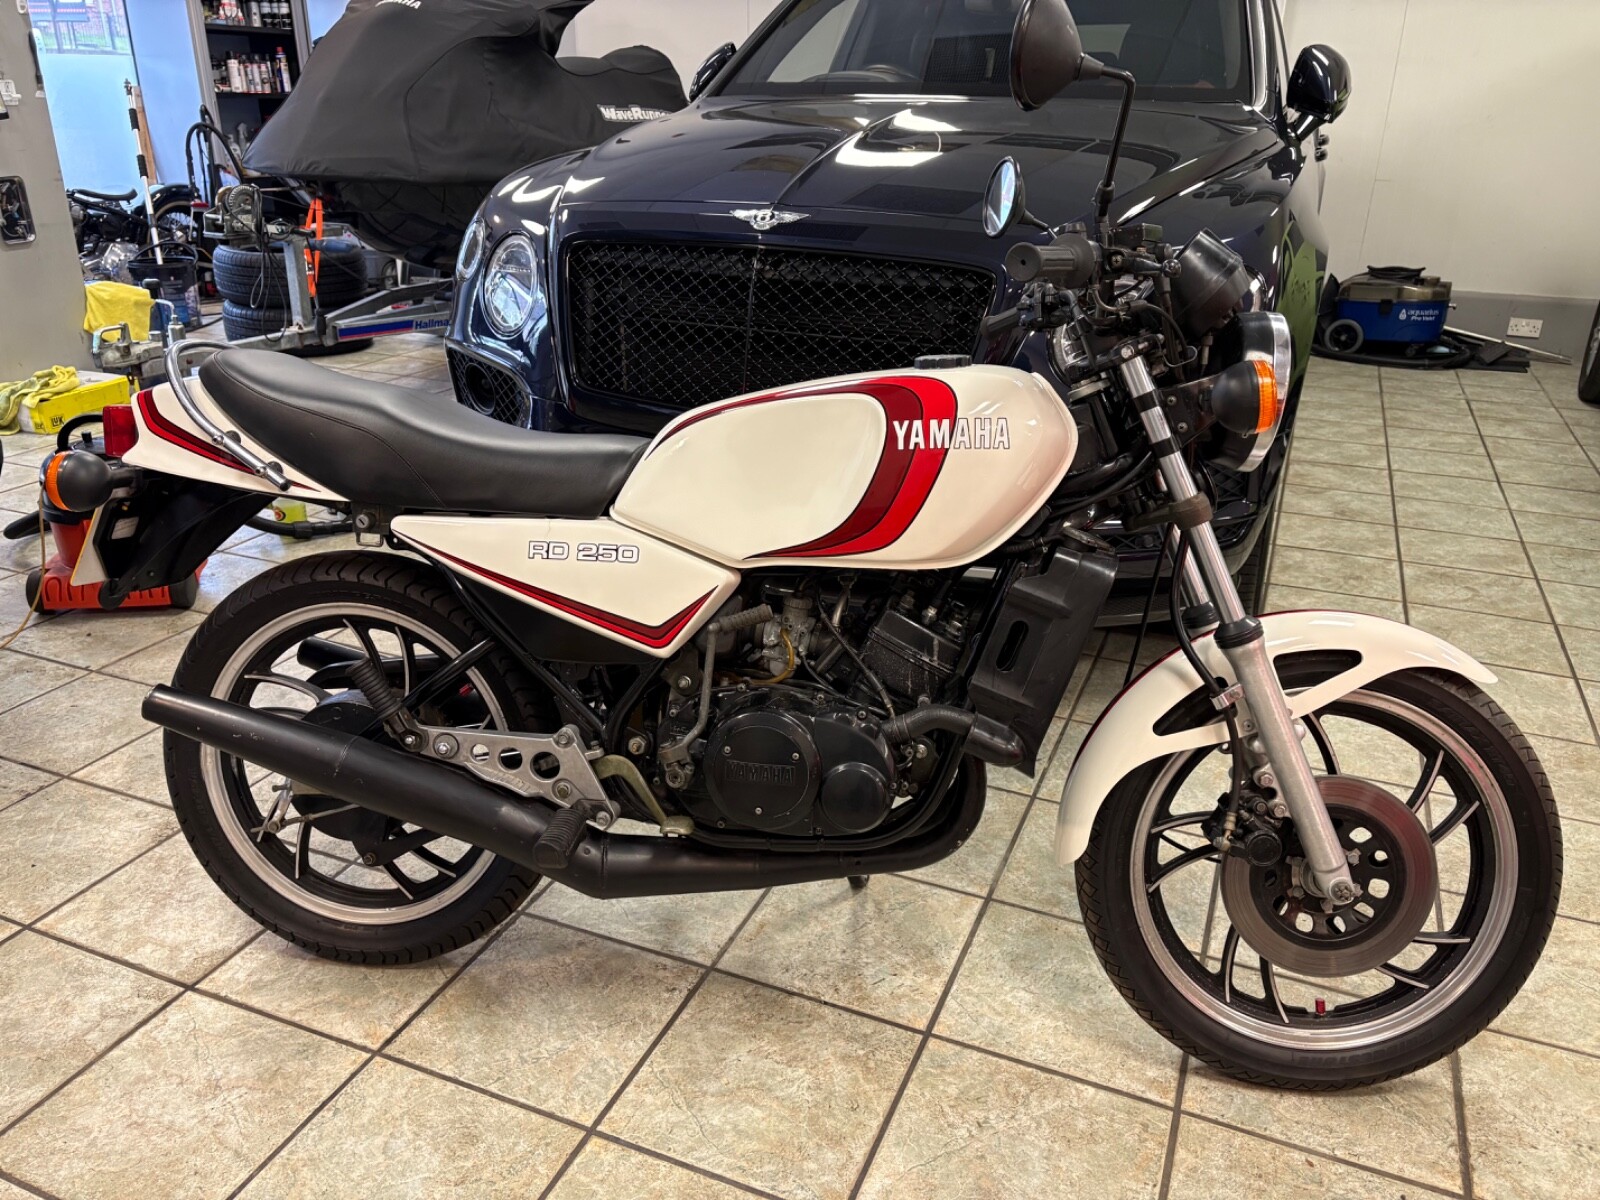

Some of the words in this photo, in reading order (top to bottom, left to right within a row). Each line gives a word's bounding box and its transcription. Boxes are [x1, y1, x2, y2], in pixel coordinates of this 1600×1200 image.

[415, 319, 451, 329] Hallma
[892, 417, 1011, 450] YAMAHA
[528, 540, 570, 561] RD
[576, 542, 640, 564] 250
[727, 761, 794, 785] YAMAHA
